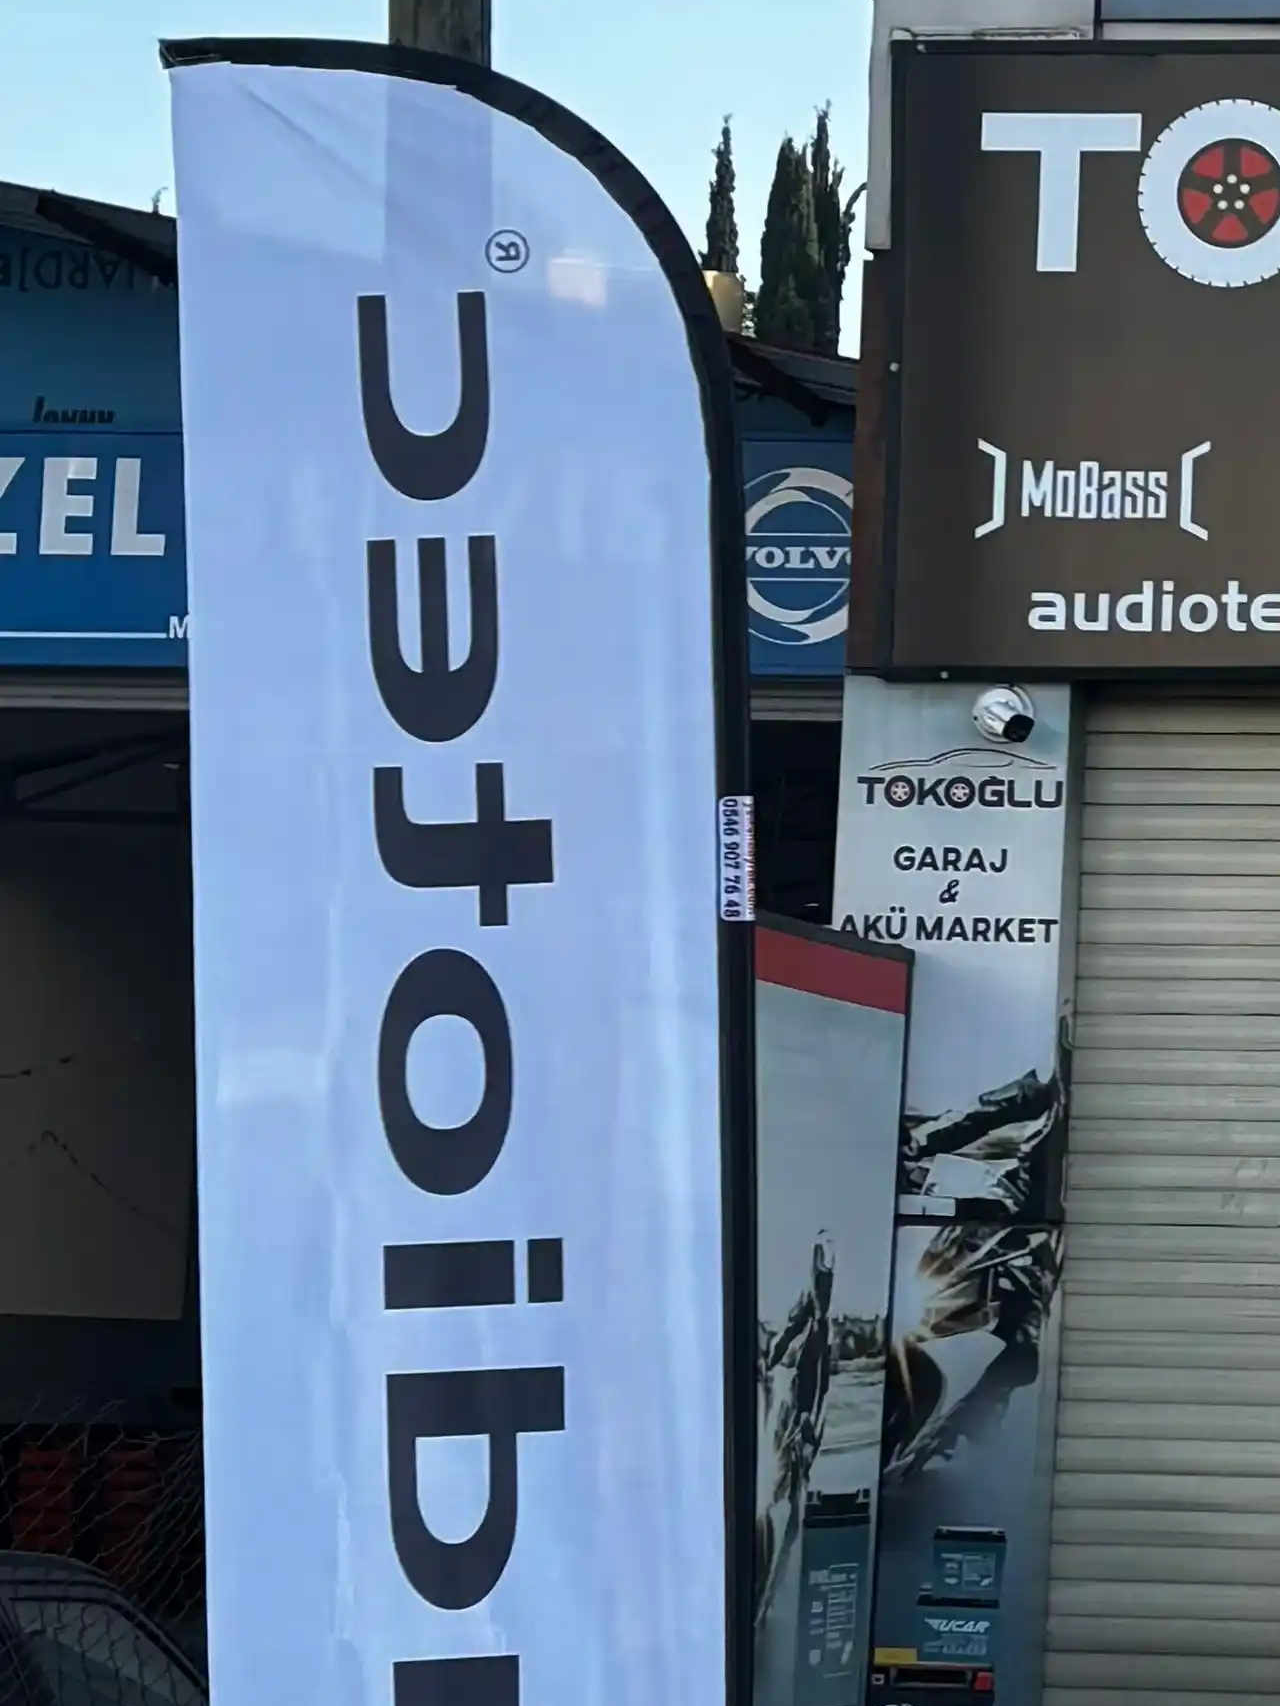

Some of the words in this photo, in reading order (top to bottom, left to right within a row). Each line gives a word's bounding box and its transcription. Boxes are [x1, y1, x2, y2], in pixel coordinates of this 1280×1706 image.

[745, 545, 852, 569] OLV
[857, 774, 1064, 810] TOKOĞLU
[893, 845, 1008, 873] GARAJ
[938, 879, 960, 904] &
[840, 905, 907, 942] AKÜ
[915, 917, 1059, 944] MARKET
